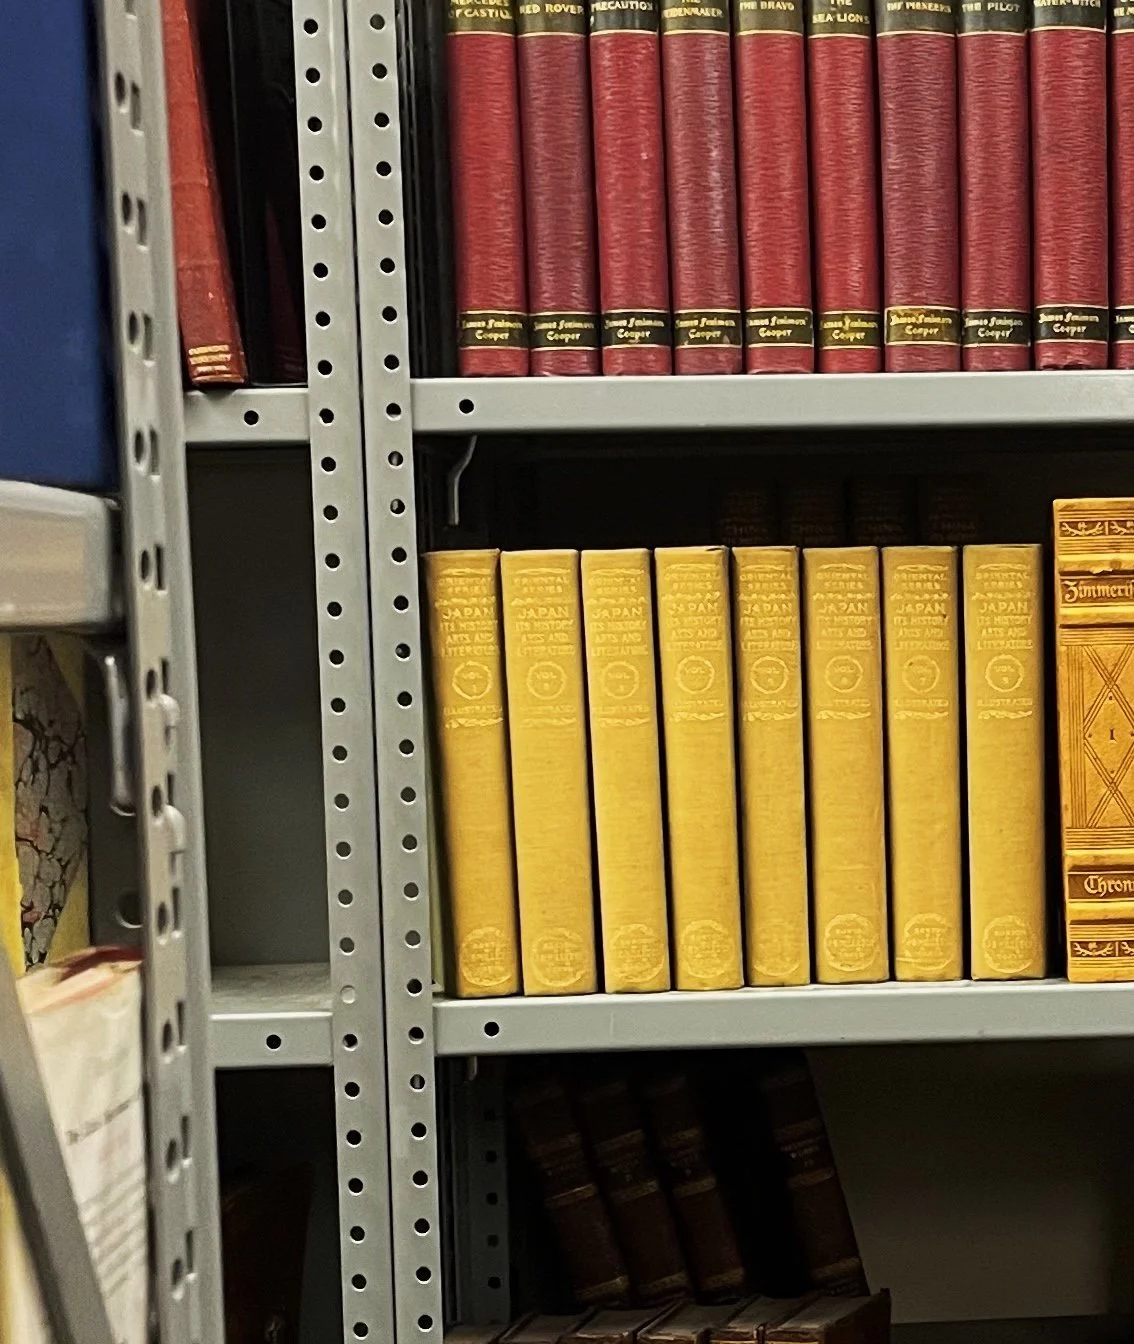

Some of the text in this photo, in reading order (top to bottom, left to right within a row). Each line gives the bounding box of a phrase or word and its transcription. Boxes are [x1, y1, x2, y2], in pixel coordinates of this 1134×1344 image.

[760, 1, 795, 11] BRAVO
[987, 2, 1021, 13] PILOT
[812, 14, 833, 24] SEA
[442, 607, 495, 618] JAPAN
[518, 606, 570, 618] JAPAN
[592, 607, 643, 618] JAPAN
[670, 602, 718, 614] JAPAN
[743, 602, 793, 614] JAPAN
[820, 602, 869, 614] JAPAN
[898, 603, 946, 614] JAPAN
[979, 602, 1029, 613] JAPAN
[1108, 728, 1116, 741] I
